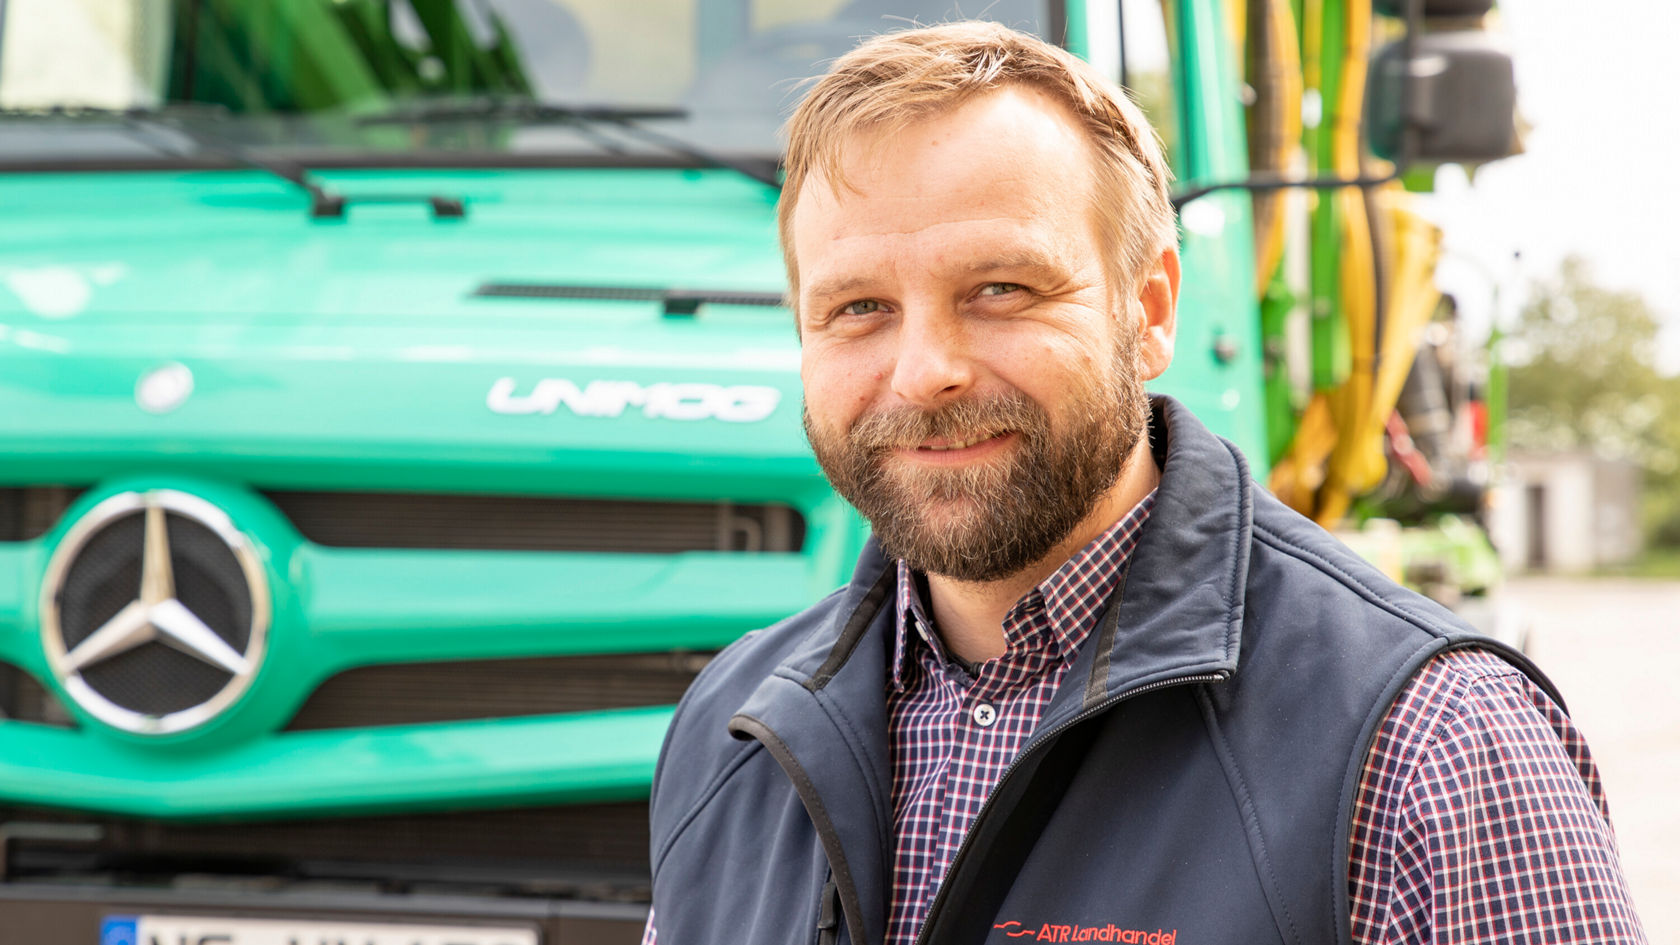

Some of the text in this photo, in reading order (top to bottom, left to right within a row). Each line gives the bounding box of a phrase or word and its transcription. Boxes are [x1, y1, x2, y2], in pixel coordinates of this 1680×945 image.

[487, 377, 780, 421] UNIMOG
[1037, 923, 1177, 945] ATR Landhandel
